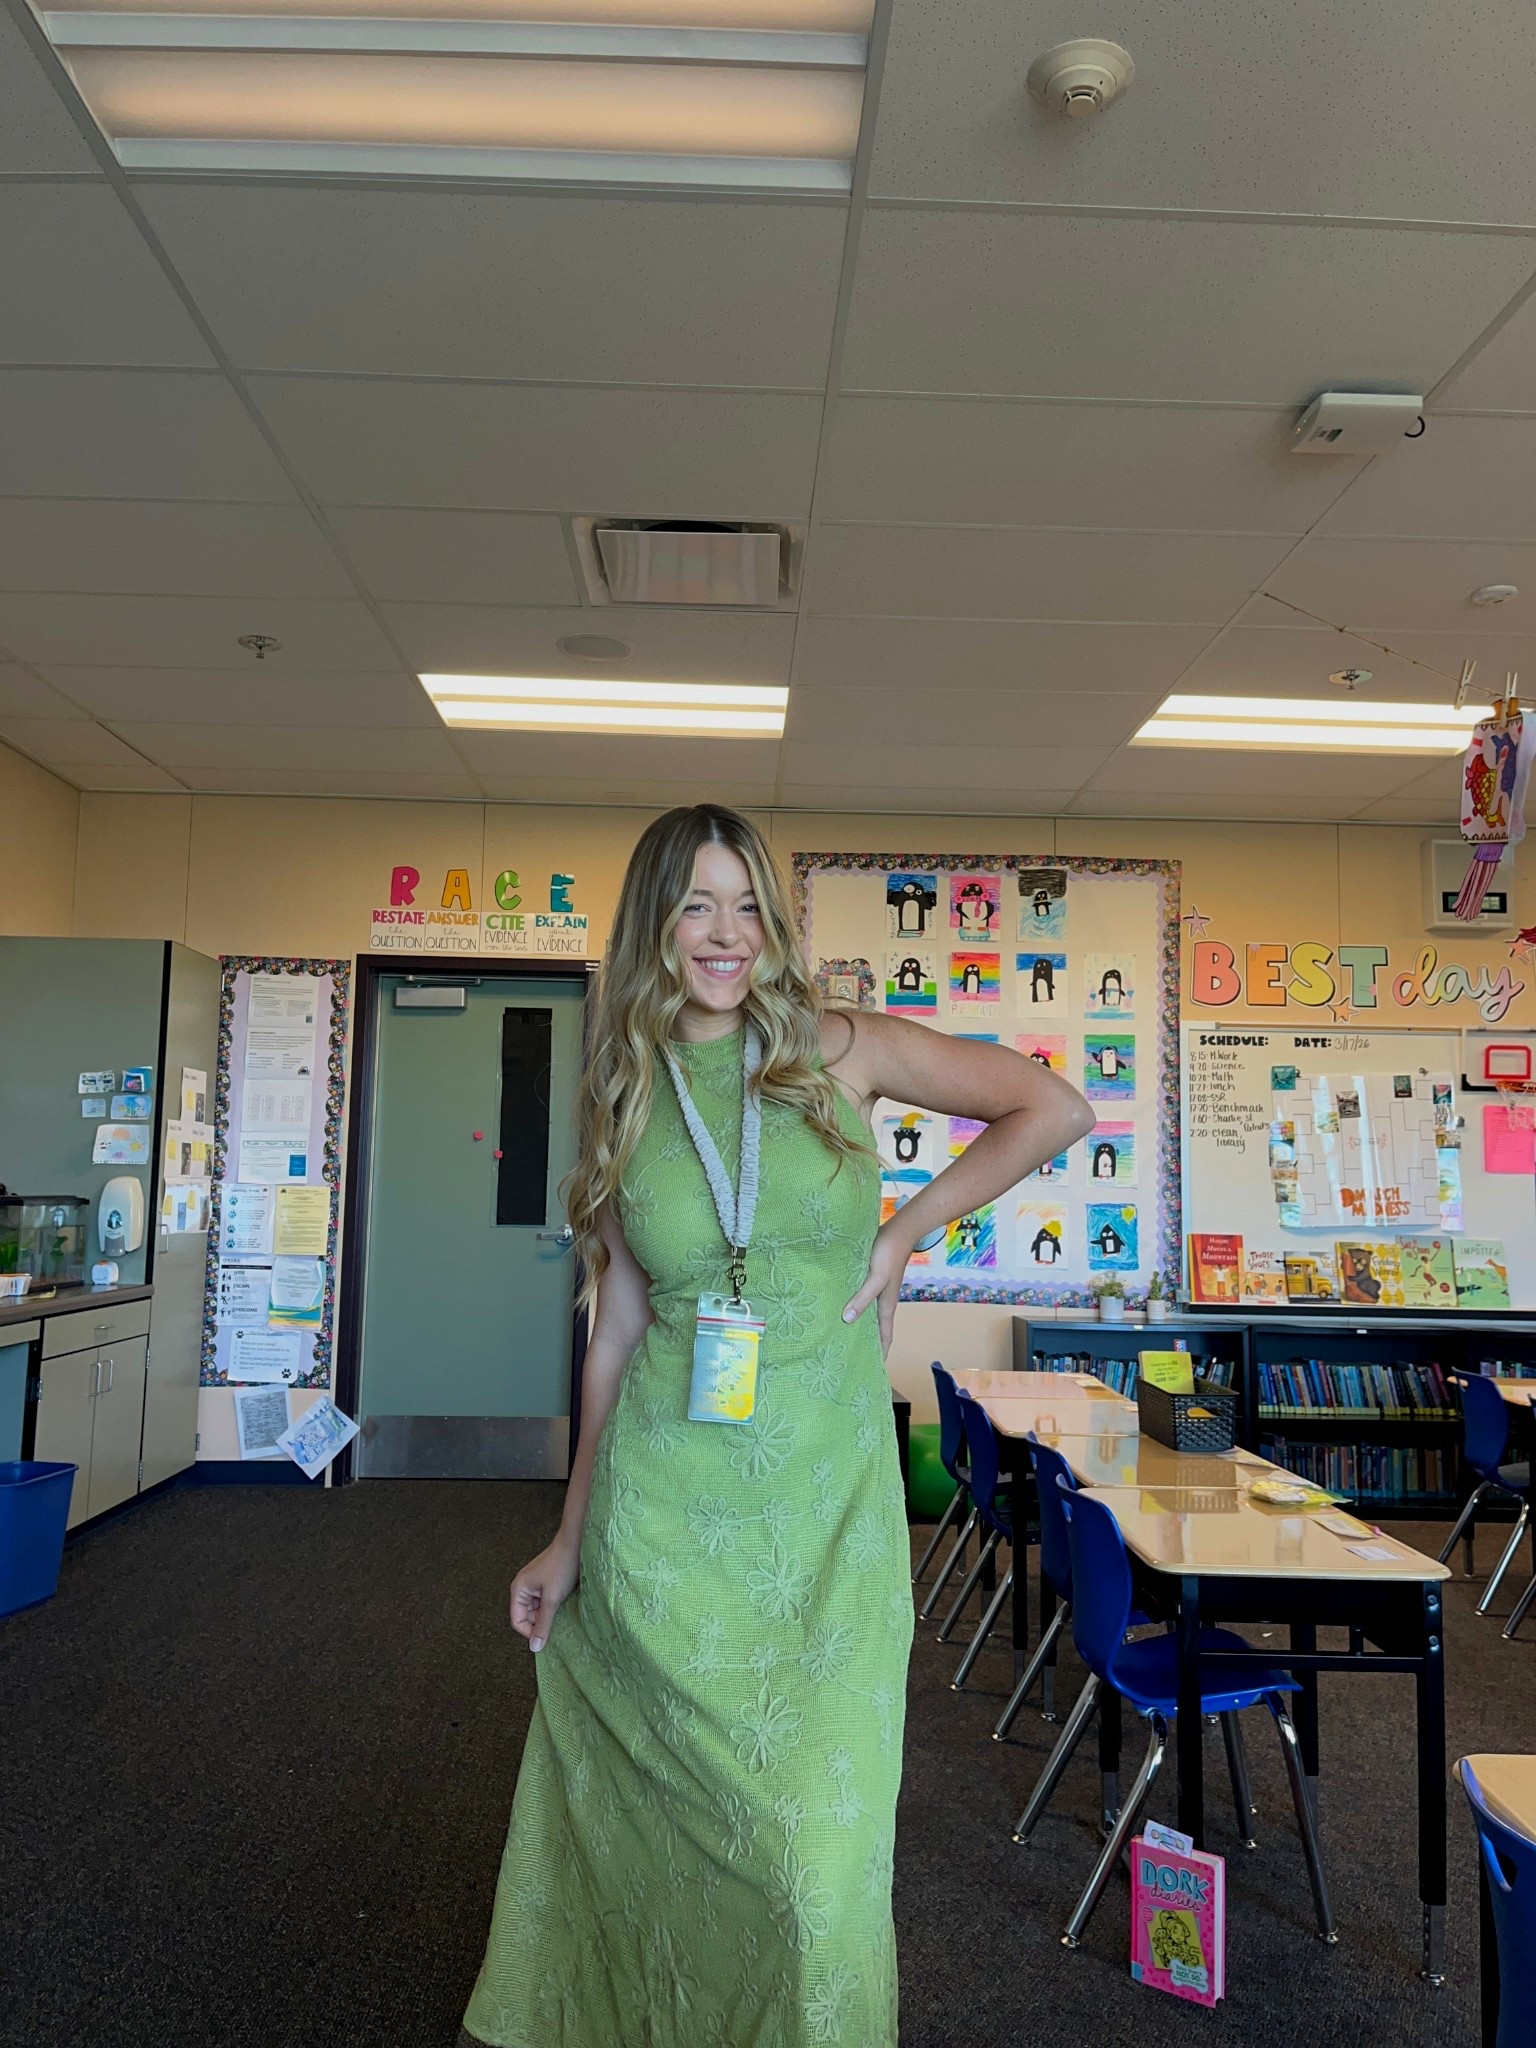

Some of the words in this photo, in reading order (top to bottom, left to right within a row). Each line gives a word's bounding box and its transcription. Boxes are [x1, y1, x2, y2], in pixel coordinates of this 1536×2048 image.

[372, 910, 425, 925] RESTATE
[427, 912, 479, 926] ANSWER
[486, 914, 525, 931] CITE
[535, 915, 587, 929] EXPLAIN
[388, 926, 406, 934] the
[443, 928, 461, 936] the
[484, 930, 528, 944] EVIDENCE
[371, 935, 422, 949] QUESTION
[426, 936, 477, 950] QUESTION
[537, 938, 582, 952] EVIDENCE
[1191, 941, 1388, 1008] BEST
[1393, 944, 1524, 1022] day
[1199, 1035, 1269, 1047] SCHEDULE:
[1294, 1037, 1332, 1048] DATE:
[1216, 1137, 1246, 1154] library
[1141, 1860, 1208, 1902] DORK
[1150, 1883, 1201, 1910] diaries
